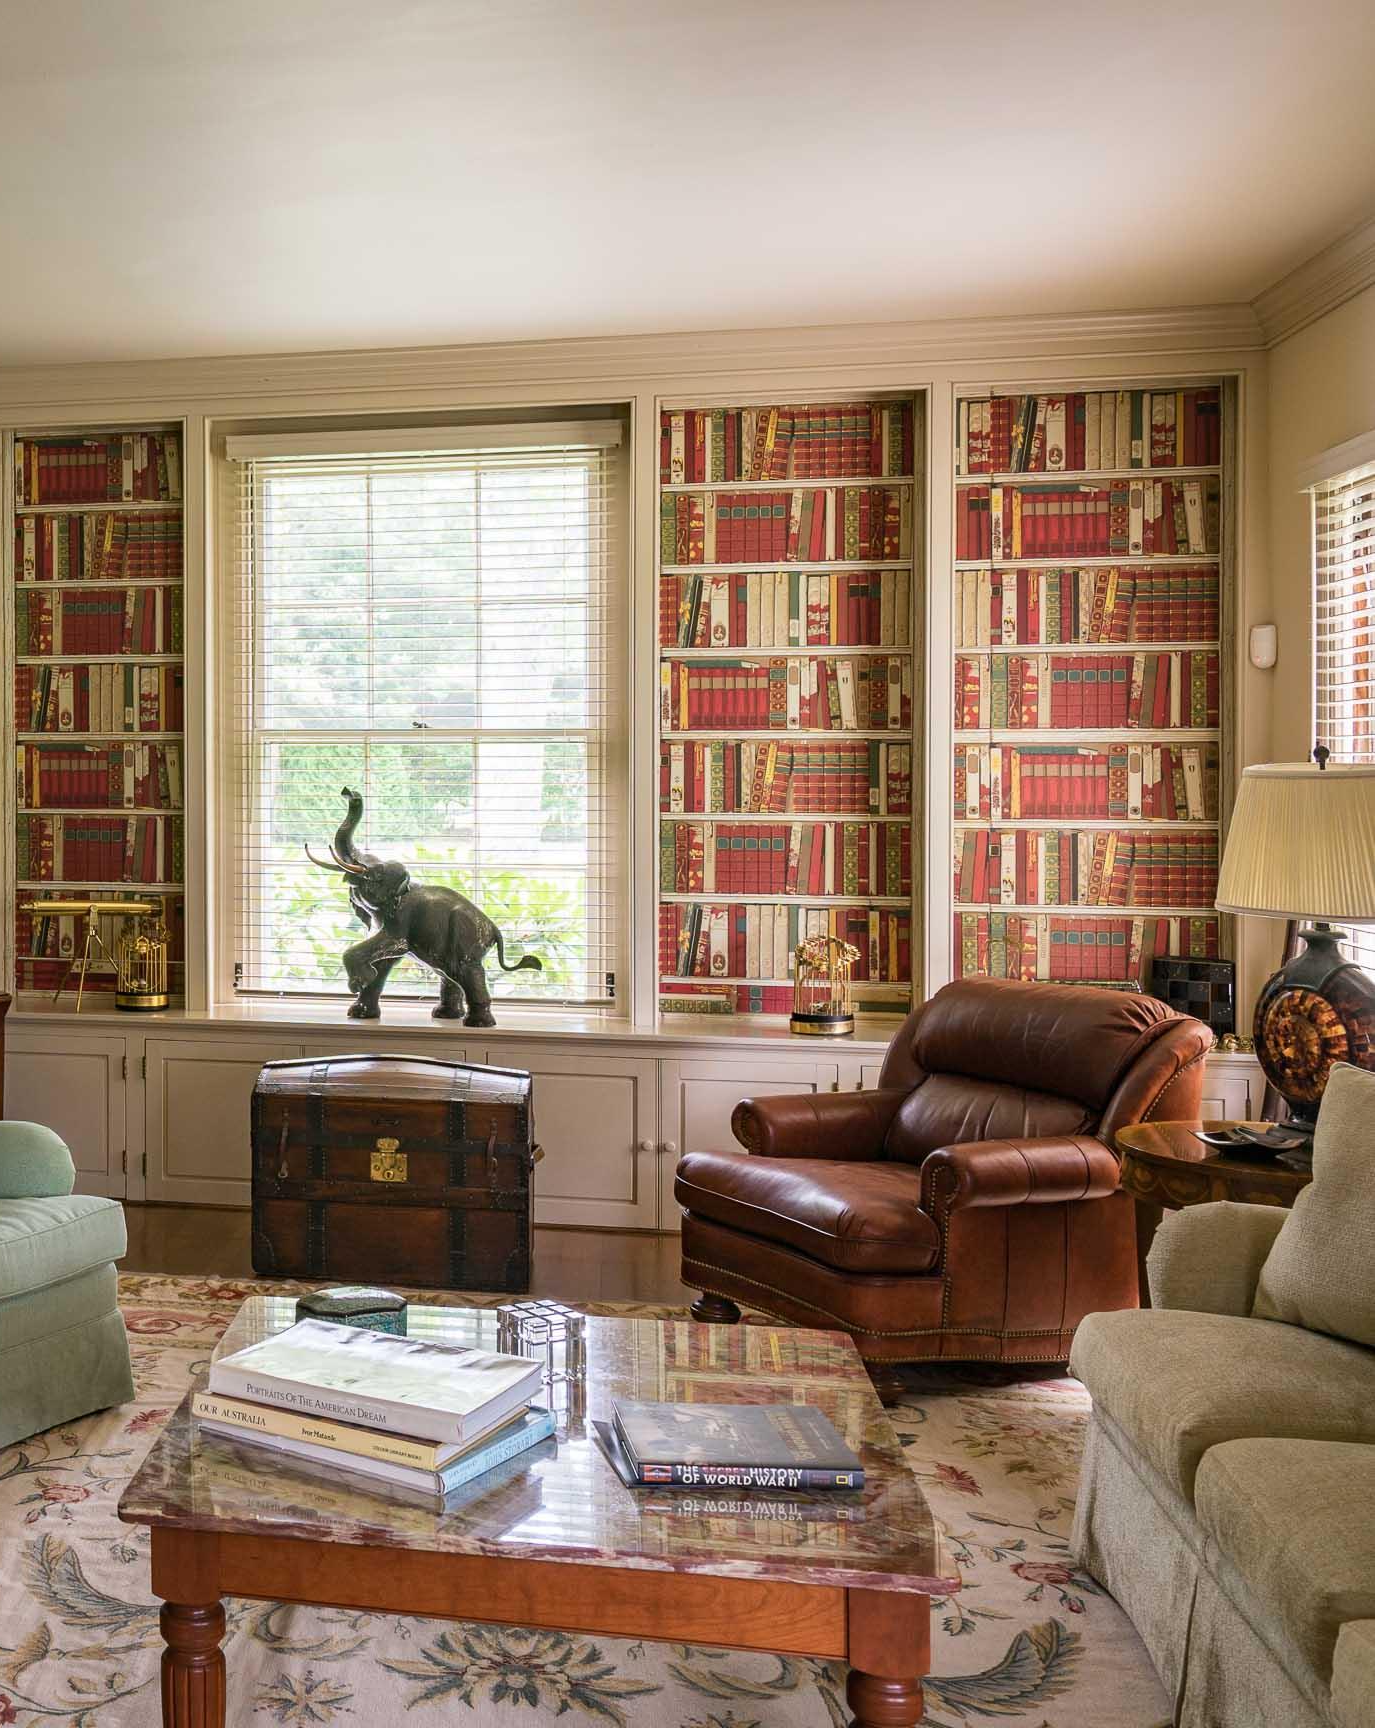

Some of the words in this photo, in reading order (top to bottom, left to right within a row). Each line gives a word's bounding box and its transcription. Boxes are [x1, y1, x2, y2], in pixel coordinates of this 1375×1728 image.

[199, 1402, 218, 1415] OUR
[221, 1407, 266, 1427] AUSTRALIA
[676, 1465, 699, 1475] THE
[749, 1468, 803, 1480] HISTORY
[682, 1474, 700, 1484] OF
[703, 1475, 752, 1486] WORLD
[755, 1476, 786, 1487] WAR
[789, 1476, 798, 1488] II
